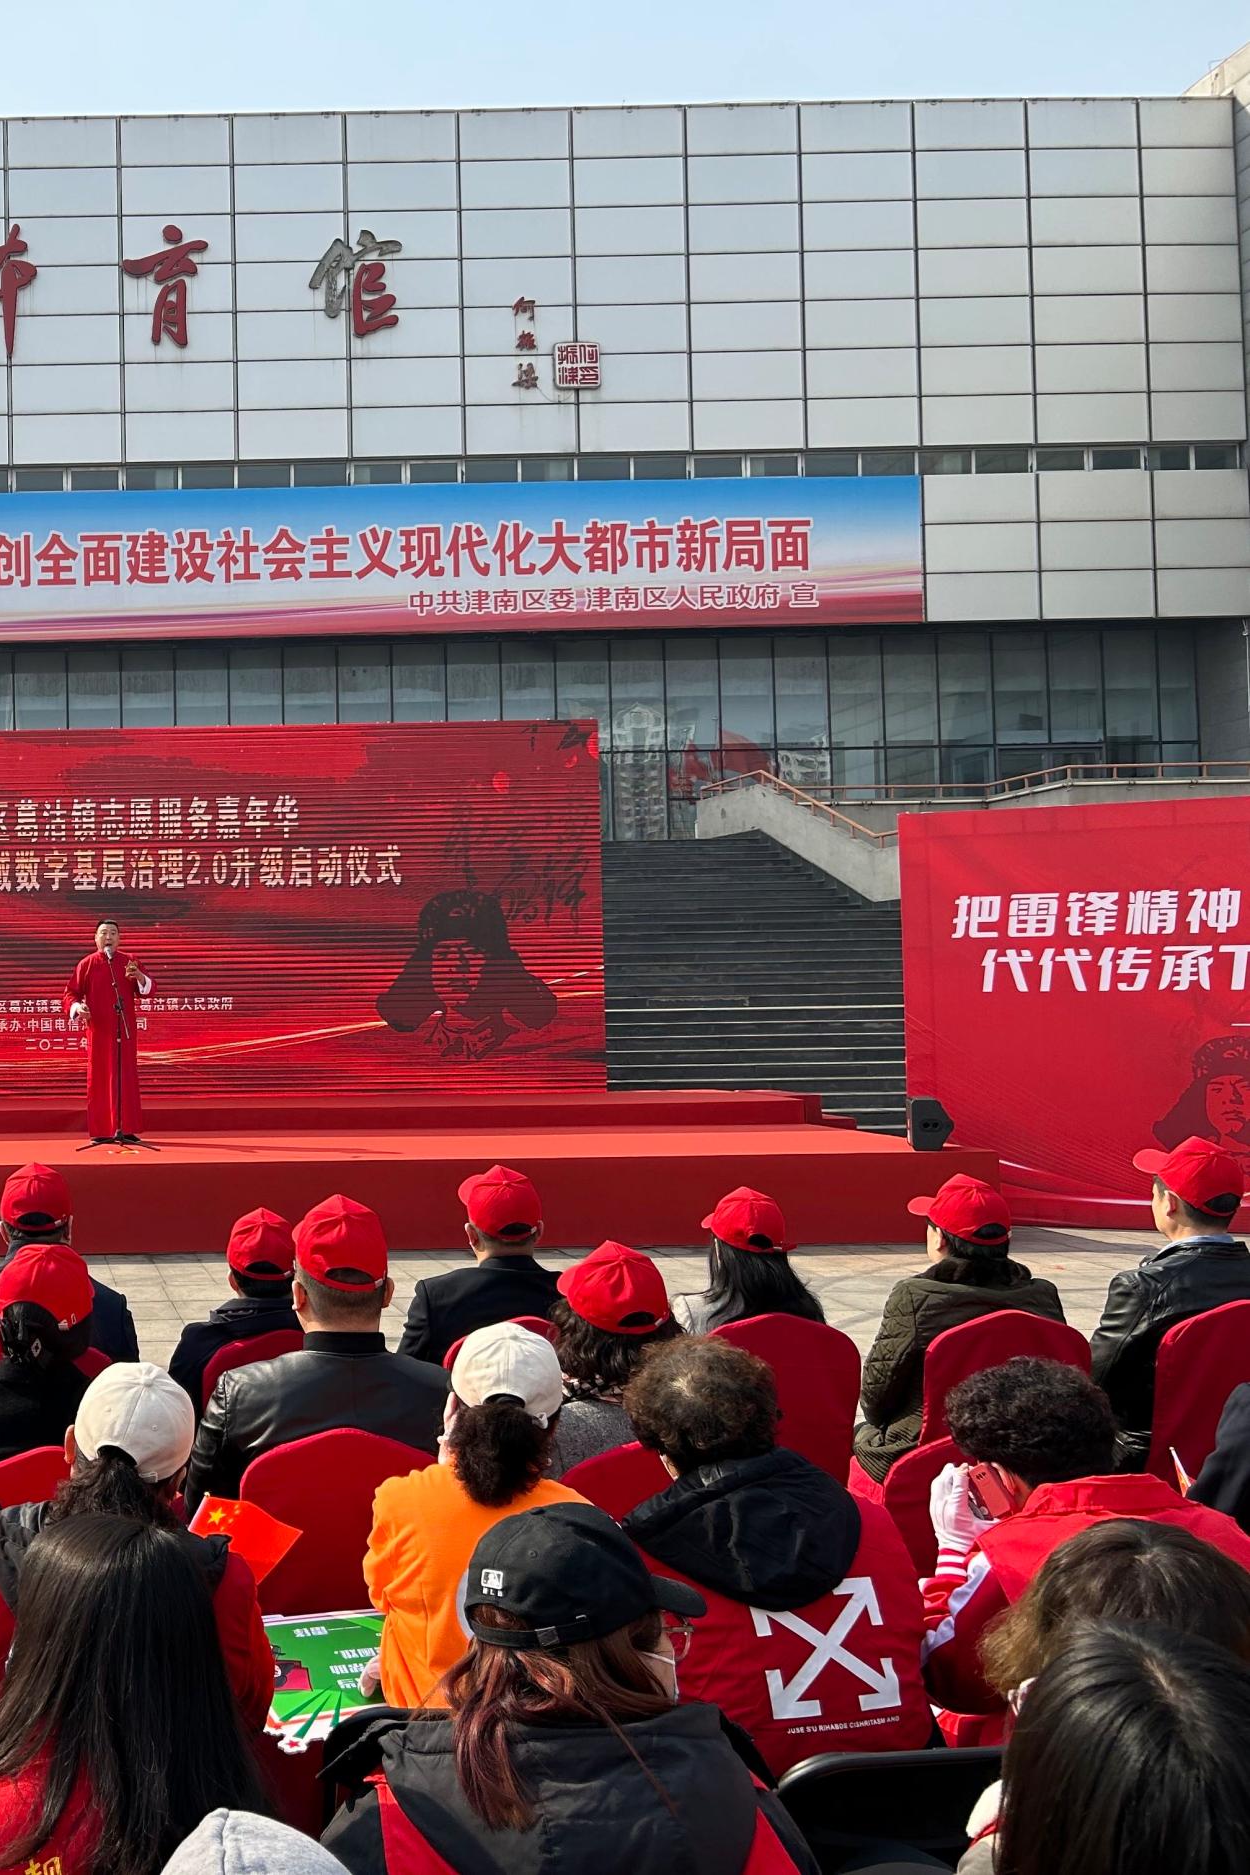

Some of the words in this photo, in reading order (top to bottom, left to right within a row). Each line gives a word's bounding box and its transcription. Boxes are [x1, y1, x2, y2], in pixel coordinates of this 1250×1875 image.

[408, 587, 577, 617] 中共津南区委
[585, 583, 781, 613] 津南区人民政府
[789, 582, 820, 610] 宣
[951, 887, 1241, 939] 把雷锋精神
